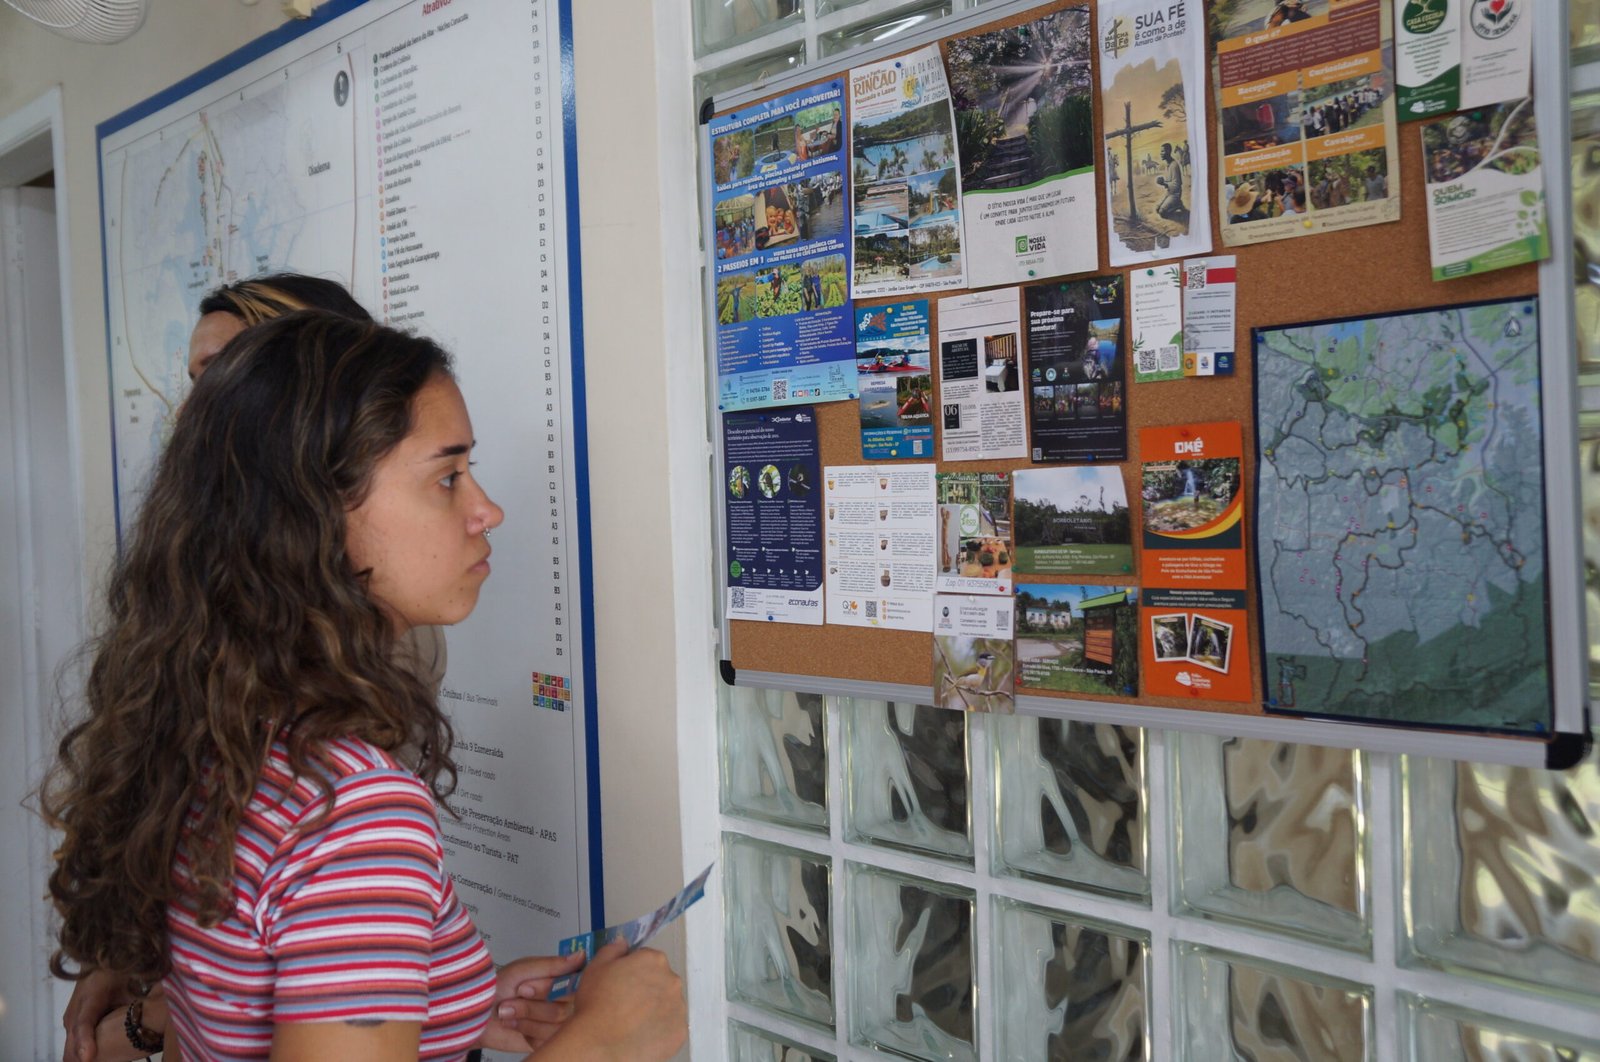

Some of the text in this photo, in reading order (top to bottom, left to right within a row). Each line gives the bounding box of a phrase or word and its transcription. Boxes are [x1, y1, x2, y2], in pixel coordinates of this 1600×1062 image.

[1135, 10, 1164, 30] SUA
[1134, 31, 1140, 40] é
[1141, 26, 1166, 38] como
[1175, 20, 1186, 29] de
[1134, 38, 1154, 48] Amaro
[1163, 28, 1186, 40] Pontes?
[1255, 34, 1269, 43] que
[1308, 57, 1369, 77] Curiosidades
[882, 86, 896, 95] Lazer
[711, 121, 742, 136] ESTRUTURA
[742, 110, 770, 126] COMPLETA
[770, 106, 785, 117] PARA
[785, 98, 800, 112] VOCÊ
[800, 88, 841, 108] APROVEITAR!
[308, 161, 330, 176] Diadema
[1433, 183, 1462, 196] QUEM
[1433, 188, 1476, 206] SOMOS?
[1030, 242, 1046, 251] VIDA
[396, 258, 410, 268] Sagrado
[415, 251, 440, 262] Guarapiranga
[723, 259, 749, 272] PASSEIOS
[750, 258, 759, 266] EM
[1030, 309, 1060, 318] Prepare-se
[1041, 316, 1064, 324] próxima
[944, 405, 957, 416] 06
[788, 598, 818, 607] econautas
[469, 742, 473, 751] 9
[474, 743, 504, 758] Esmeralda
[461, 808, 557, 842] de Preservação Ambiental APAS
[481, 844, 502, 859] Turista
[507, 852, 519, 864] PAT
[457, 874, 493, 895] Conservação
[497, 889, 512, 901] Green
[513, 896, 527, 908] Areas
[528, 900, 560, 919] Conservation
